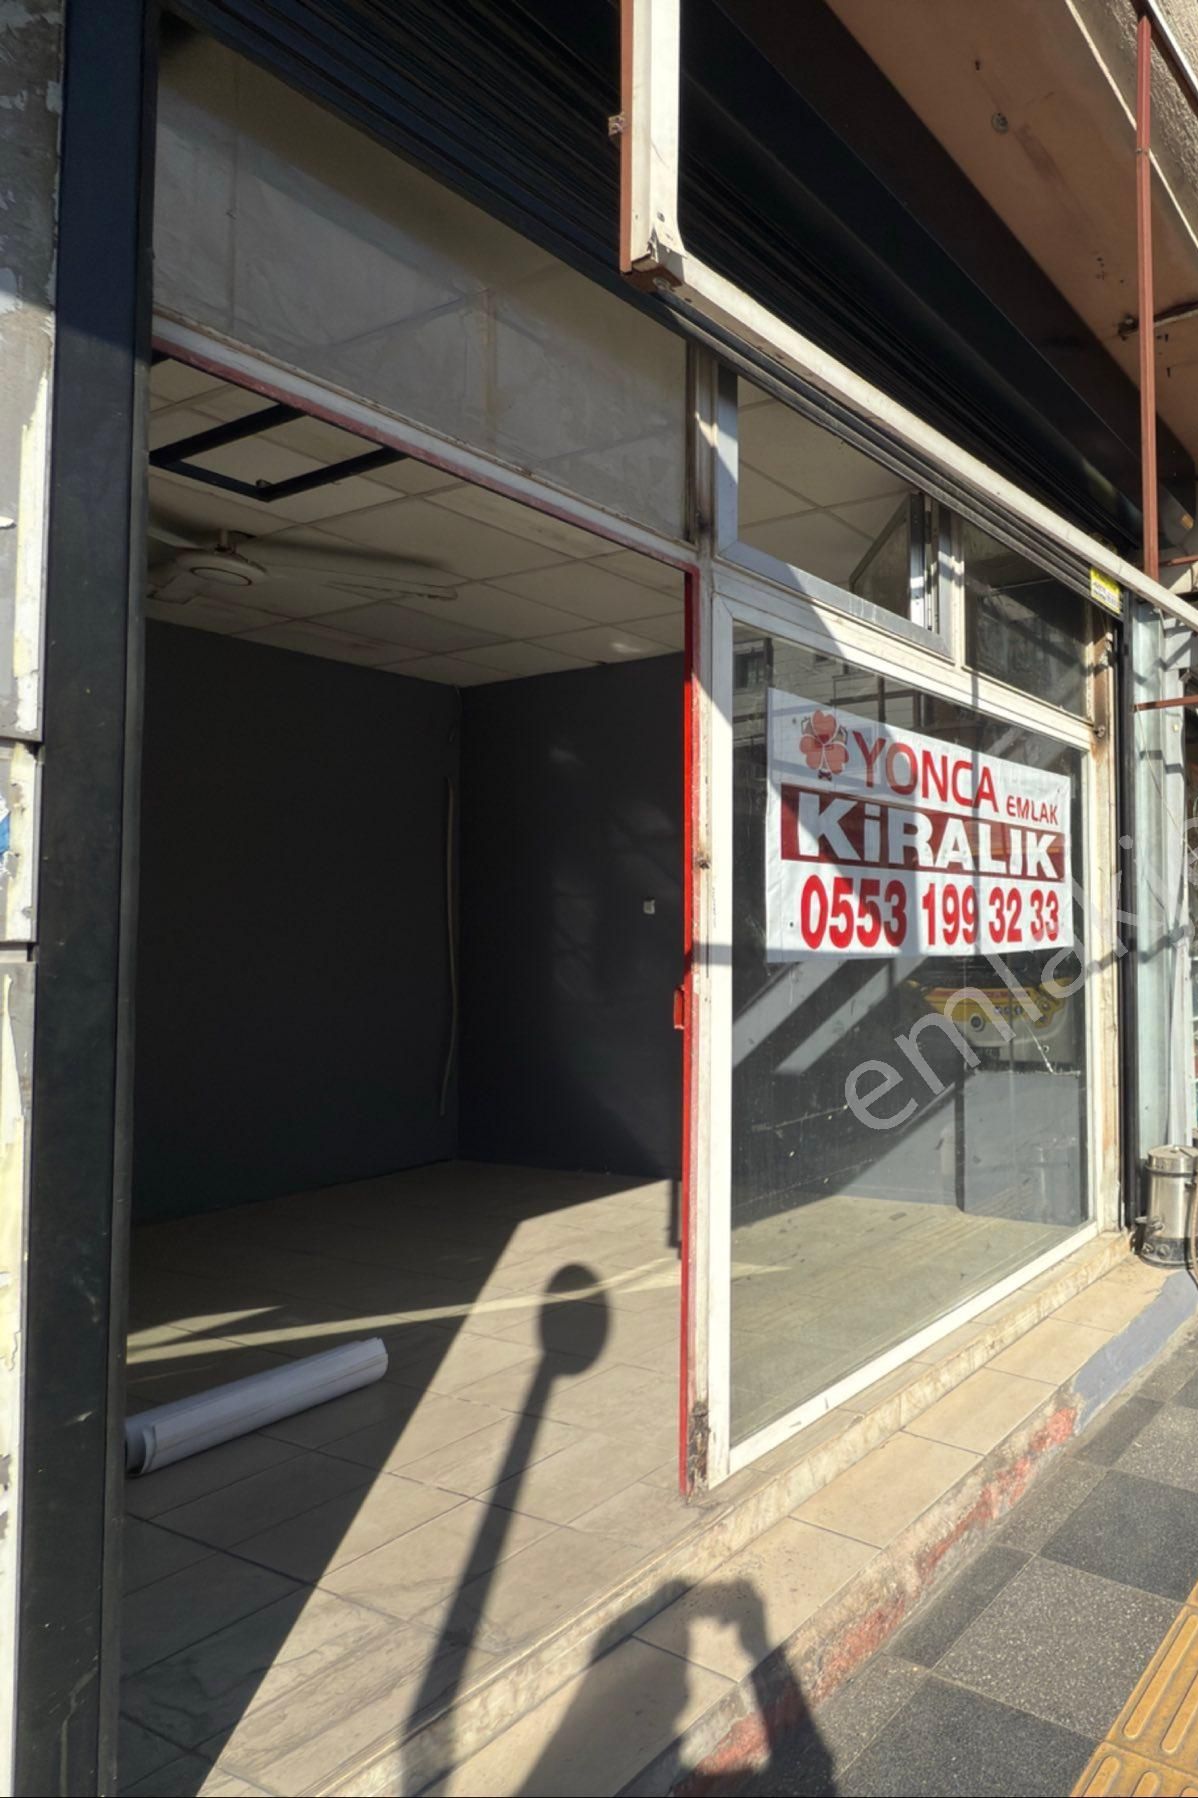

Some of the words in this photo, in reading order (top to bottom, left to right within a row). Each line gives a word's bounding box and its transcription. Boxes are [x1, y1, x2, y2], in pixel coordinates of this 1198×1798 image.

[852, 731, 999, 813] YONCA
[1006, 795, 1058, 825] EMLAK
[800, 874, 907, 949] 0553
[922, 883, 978, 945] 199
[989, 887, 1022, 943] 32
[1030, 889, 1059, 942] 33
